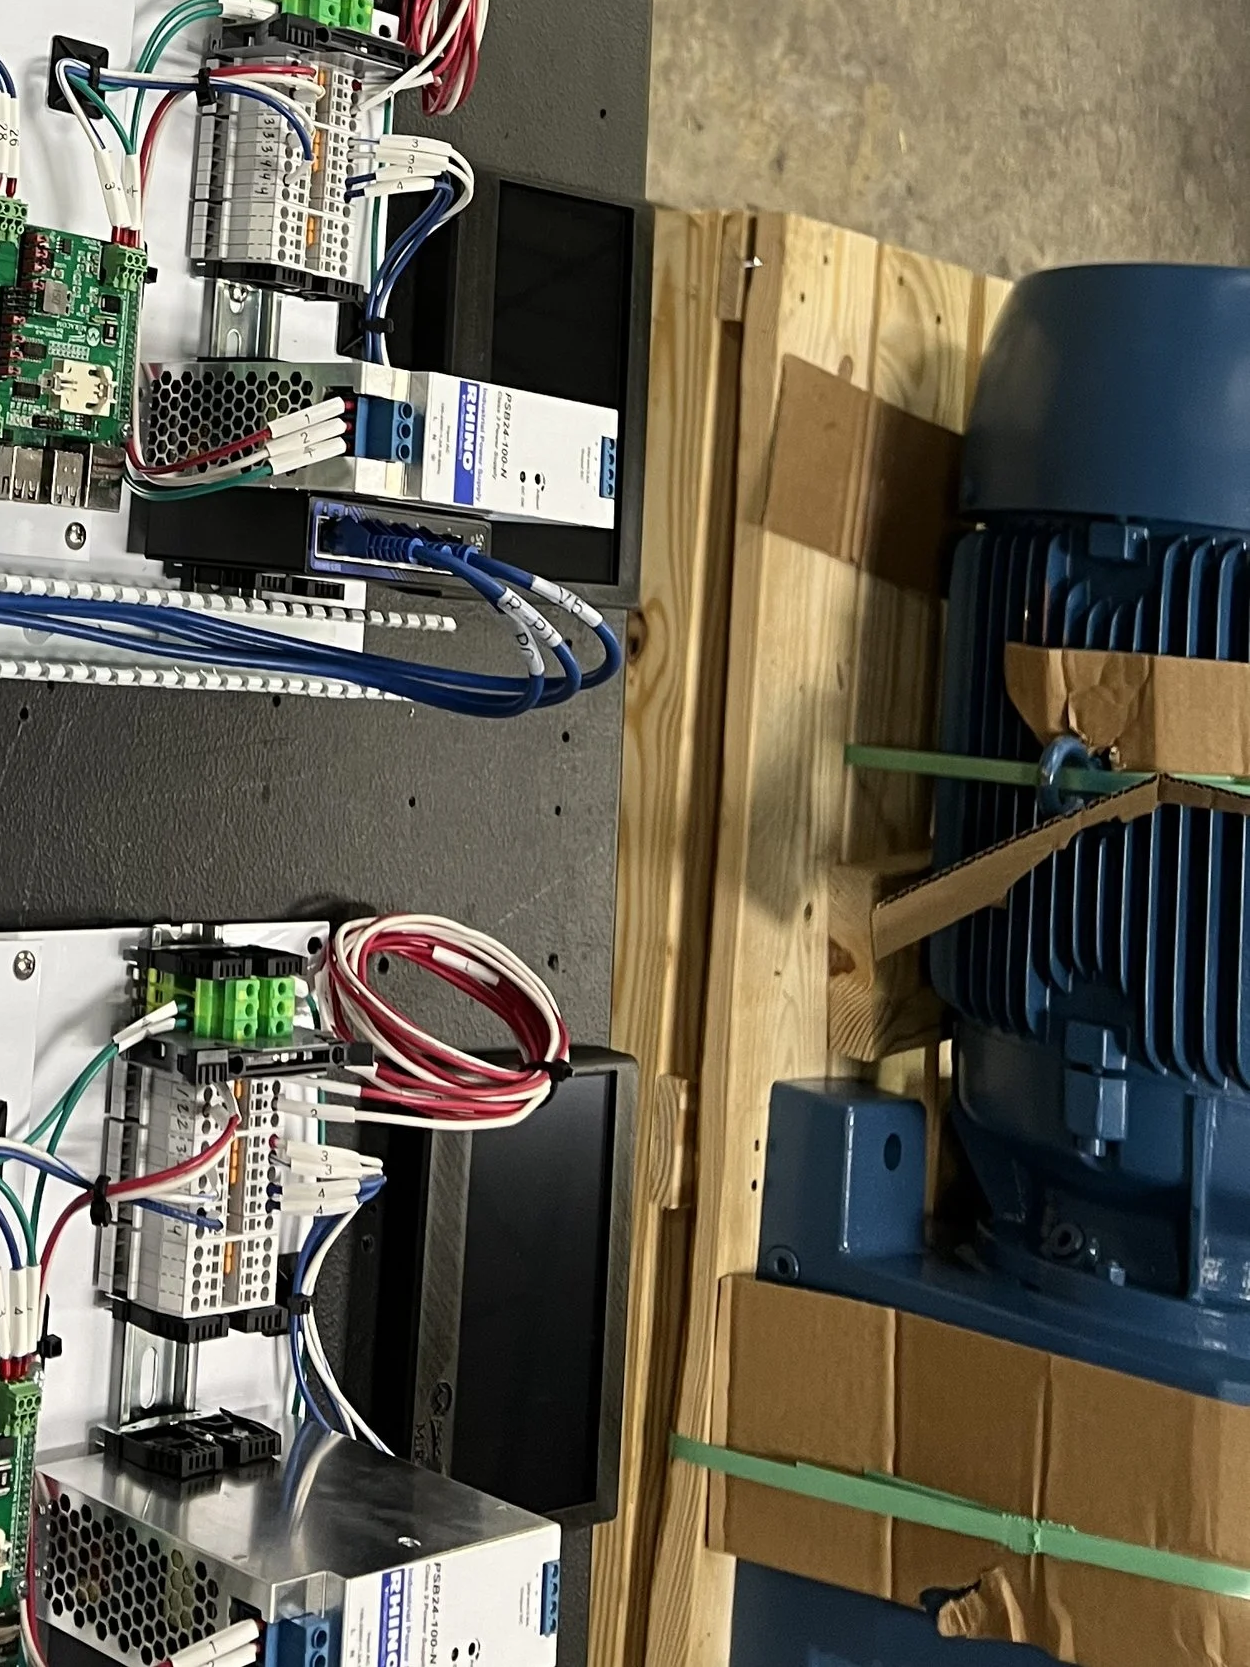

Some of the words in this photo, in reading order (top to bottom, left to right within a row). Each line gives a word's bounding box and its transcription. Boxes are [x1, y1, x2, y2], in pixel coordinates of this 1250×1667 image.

[264, 118, 275, 126] 3
[9, 129, 19, 146] 26
[263, 131, 275, 139] 3
[411, 138, 419, 148] 3
[261, 145, 273, 153] 3
[259, 160, 272, 168] 4
[408, 154, 415, 165] 3
[258, 173, 271, 181] 4
[104, 181, 116, 191] 3
[255, 187, 268, 195] 4
[397, 181, 404, 190] 4
[479, 387, 488, 433] Industrial
[305, 414, 310, 424] 1
[462, 384, 478, 471] RHINO
[300, 431, 311, 444] 2
[500, 392, 512, 479] PSB24-100-N
[475, 467, 483, 503] Supply
[176, 1088, 190, 1098] 1
[176, 1102, 190, 1115] 2
[176, 1119, 189, 1131] 2
[176, 1145, 187, 1154] 3
[321, 1150, 329, 1162] 3
[325, 1165, 333, 1176] 3
[318, 1188, 326, 1200] 4
[316, 1205, 323, 1215] 4
[167, 1225, 182, 1237] 4
[14, 1306, 23, 1315] 4
[405, 1568, 413, 1622] Industrial
[429, 1562, 441, 1664] PSB24-100-N
[209, 1640, 217, 1654] 1
[403, 1626, 411, 1662] Power
